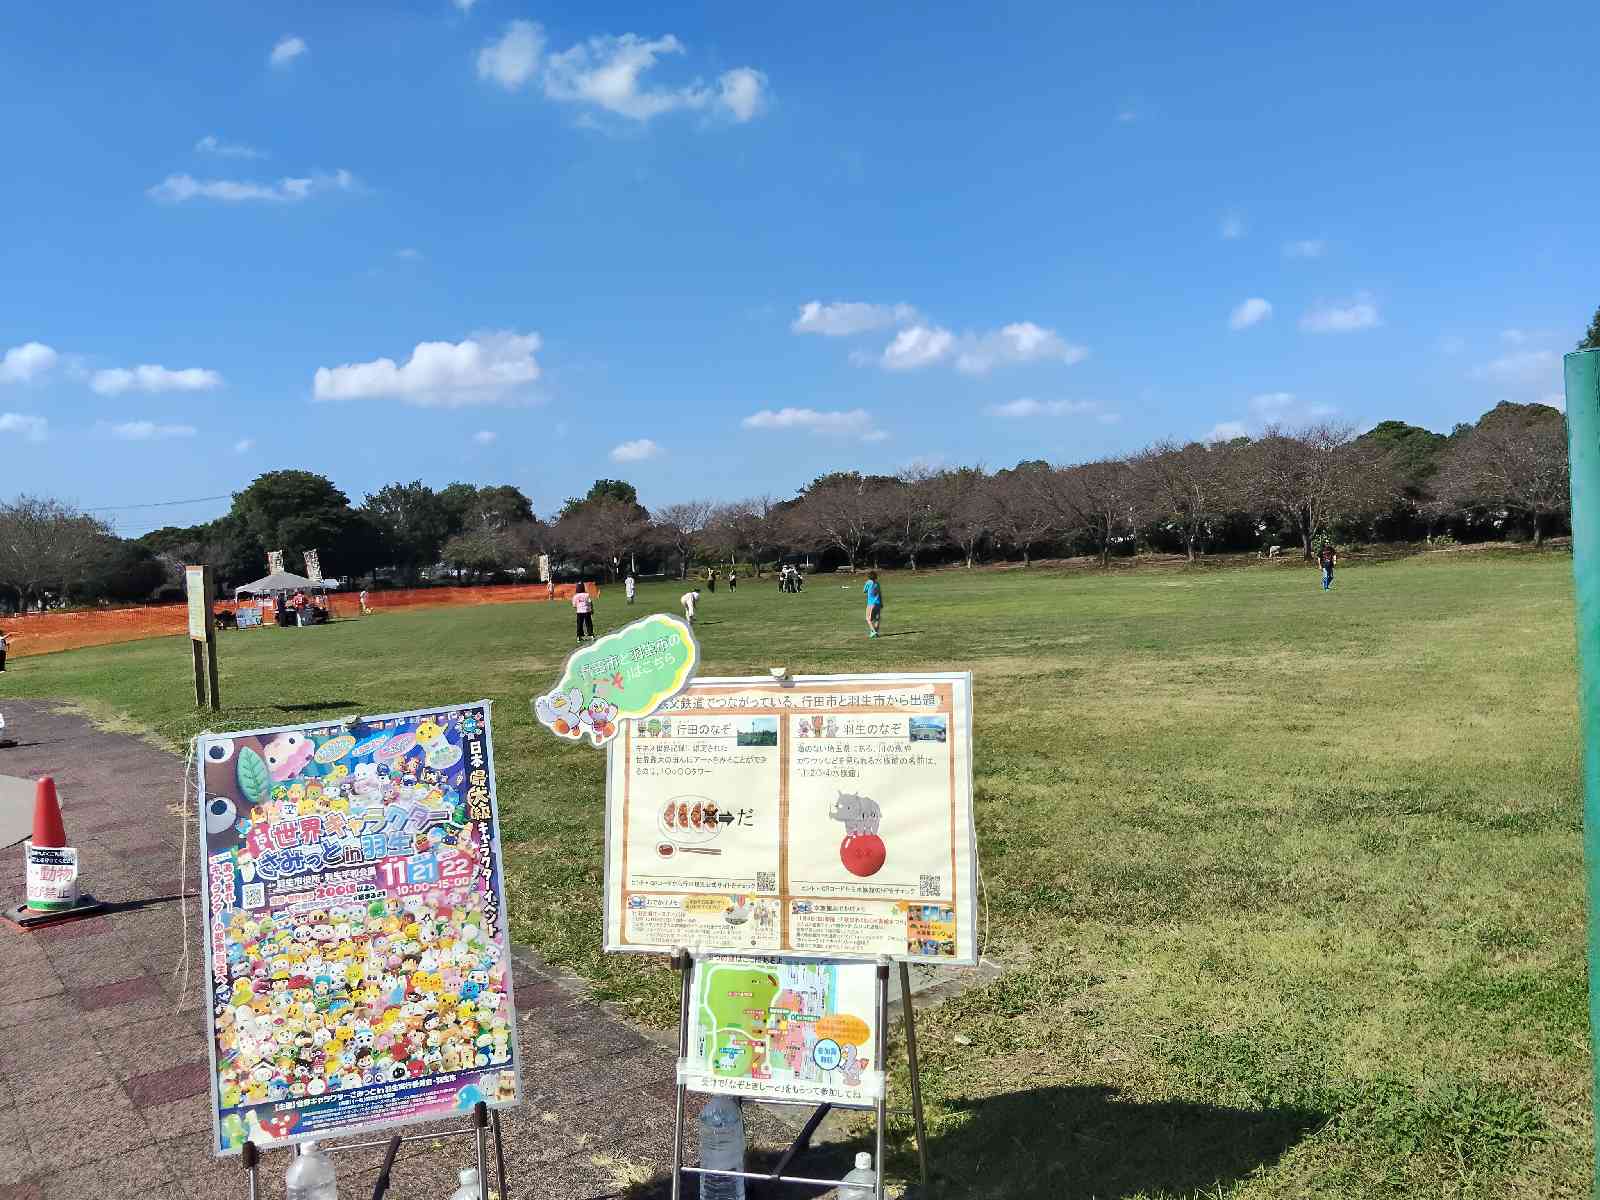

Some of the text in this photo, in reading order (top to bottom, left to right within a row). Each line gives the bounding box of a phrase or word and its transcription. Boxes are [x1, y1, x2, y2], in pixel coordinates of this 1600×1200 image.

[677, 722, 732, 736] 行田のなぞ
[843, 722, 902, 736] 羽生のなぞ
[272, 805, 452, 849] 世界キャラクター
[736, 808, 755, 827] だ
[381, 860, 406, 886] 11
[413, 862, 434, 881] 21
[442, 858, 469, 877] 22
